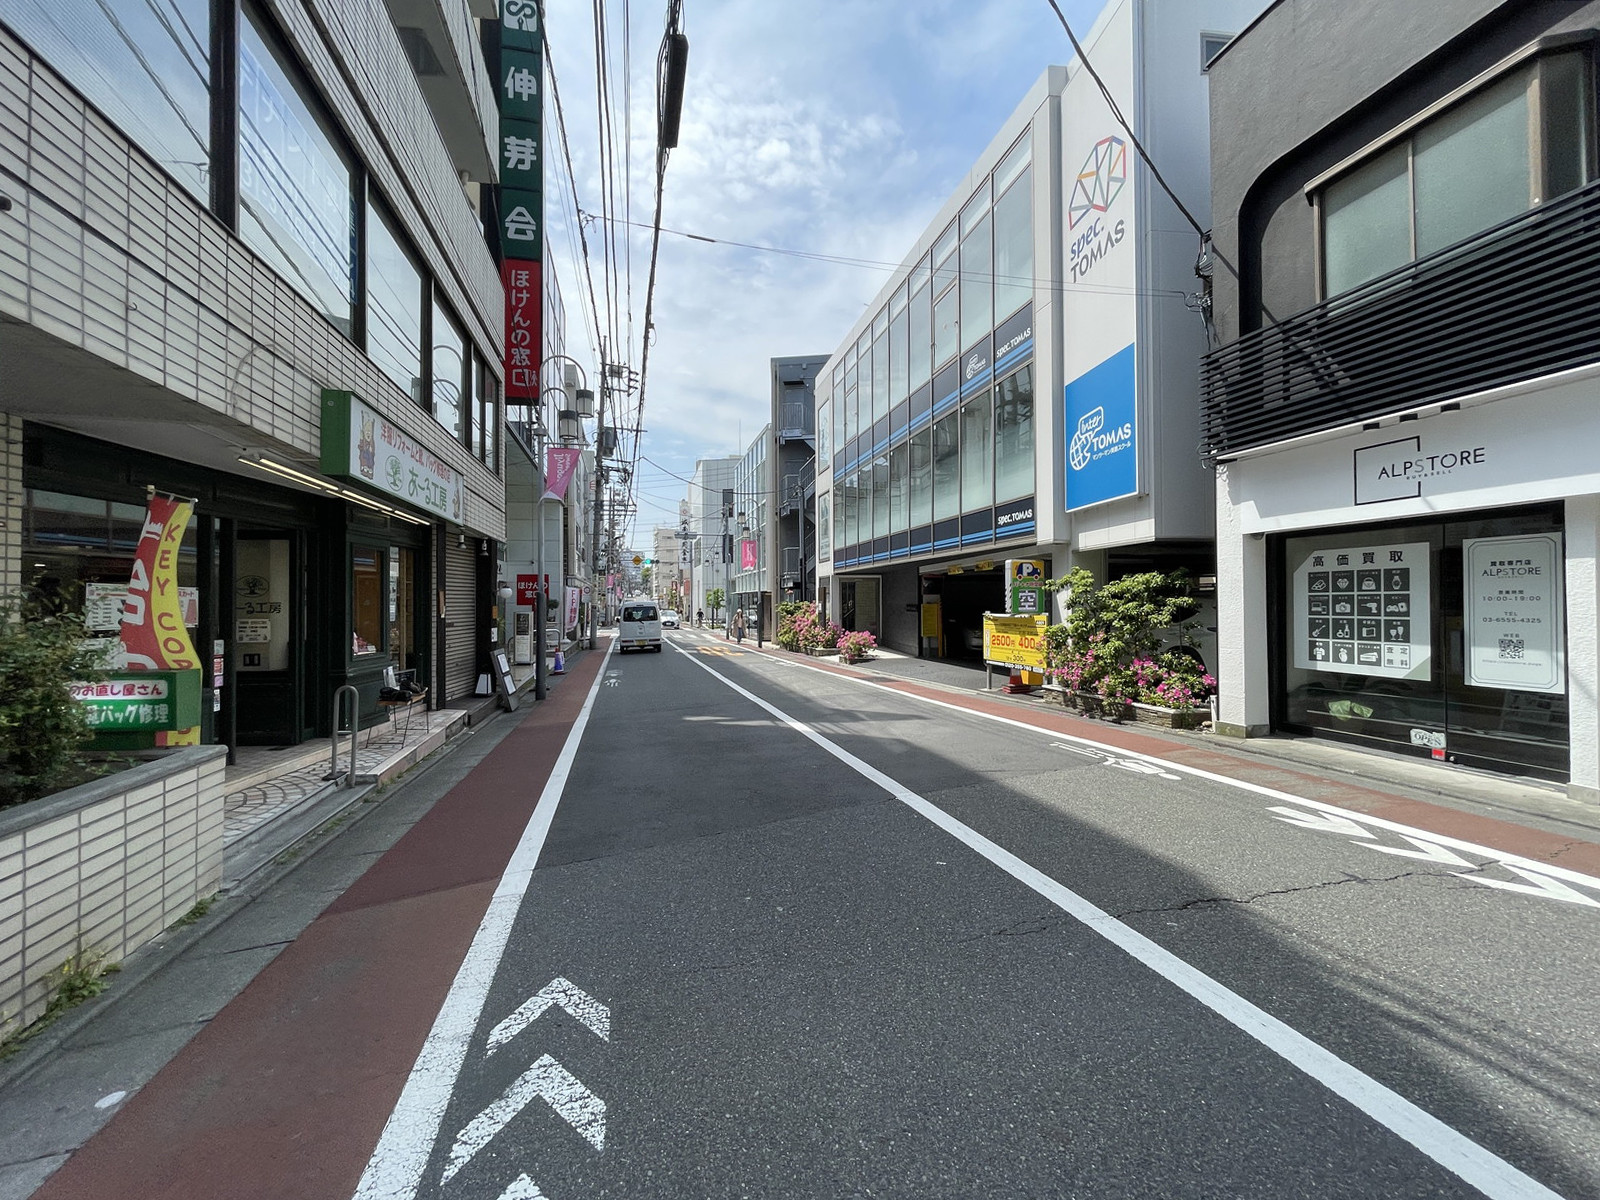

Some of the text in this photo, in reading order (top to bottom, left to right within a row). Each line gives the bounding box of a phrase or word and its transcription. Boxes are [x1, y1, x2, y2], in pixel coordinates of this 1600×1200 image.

[505, 66, 537, 241] 伸芽会
[1070, 216, 1104, 262] spec.
[1070, 219, 1125, 283] TOMAS
[510, 269, 531, 386] ほけんの窓口
[1092, 423, 1131, 452] TOMAS
[1378, 447, 1485, 480] ALPSTORE
[408, 466, 447, 512] あーる工房
[997, 509, 1033, 526] spec.TOMAS
[1022, 565, 1034, 577] P
[1312, 551, 1403, 567] 高価買取
[1482, 567, 1542, 577] ALPSTORE
